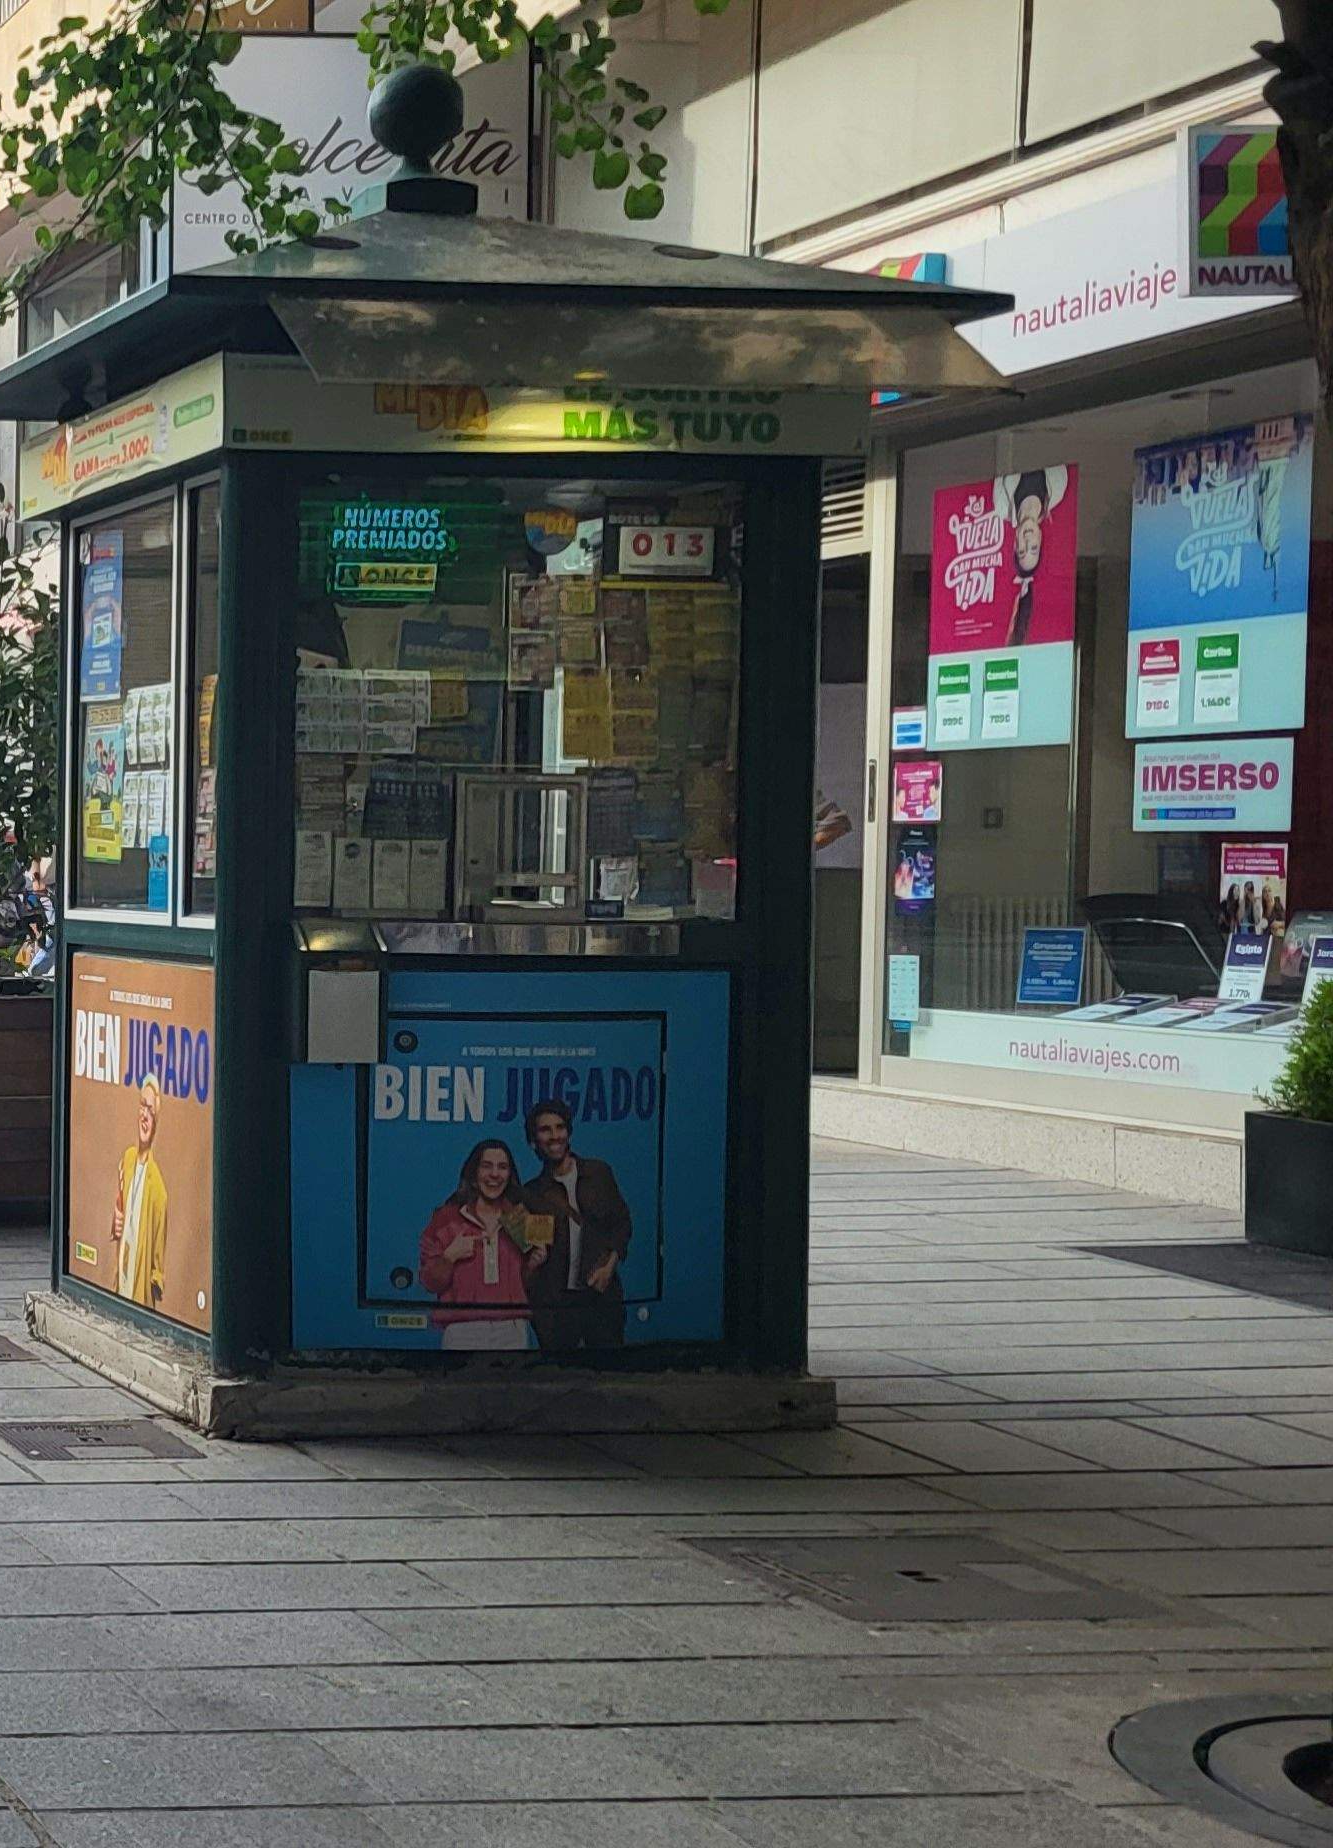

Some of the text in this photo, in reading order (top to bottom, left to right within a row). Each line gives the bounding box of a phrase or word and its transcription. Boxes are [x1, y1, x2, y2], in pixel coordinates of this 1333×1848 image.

[184, 212, 237, 225] CENTRO
[249, 431, 292, 443] ONCE
[563, 402, 781, 444] MÁS TUYO
[344, 502, 441, 528] NÚMEROS
[333, 530, 447, 551] PREMIADOS
[365, 567, 430, 584] ONCE
[1142, 762, 1280, 792] IMSERSO
[75, 1009, 209, 1104] BIEN JUGADO
[1009, 1038, 1180, 1073] nautaliaviajes.com
[374, 1064, 655, 1123] BIEN JUGADO
